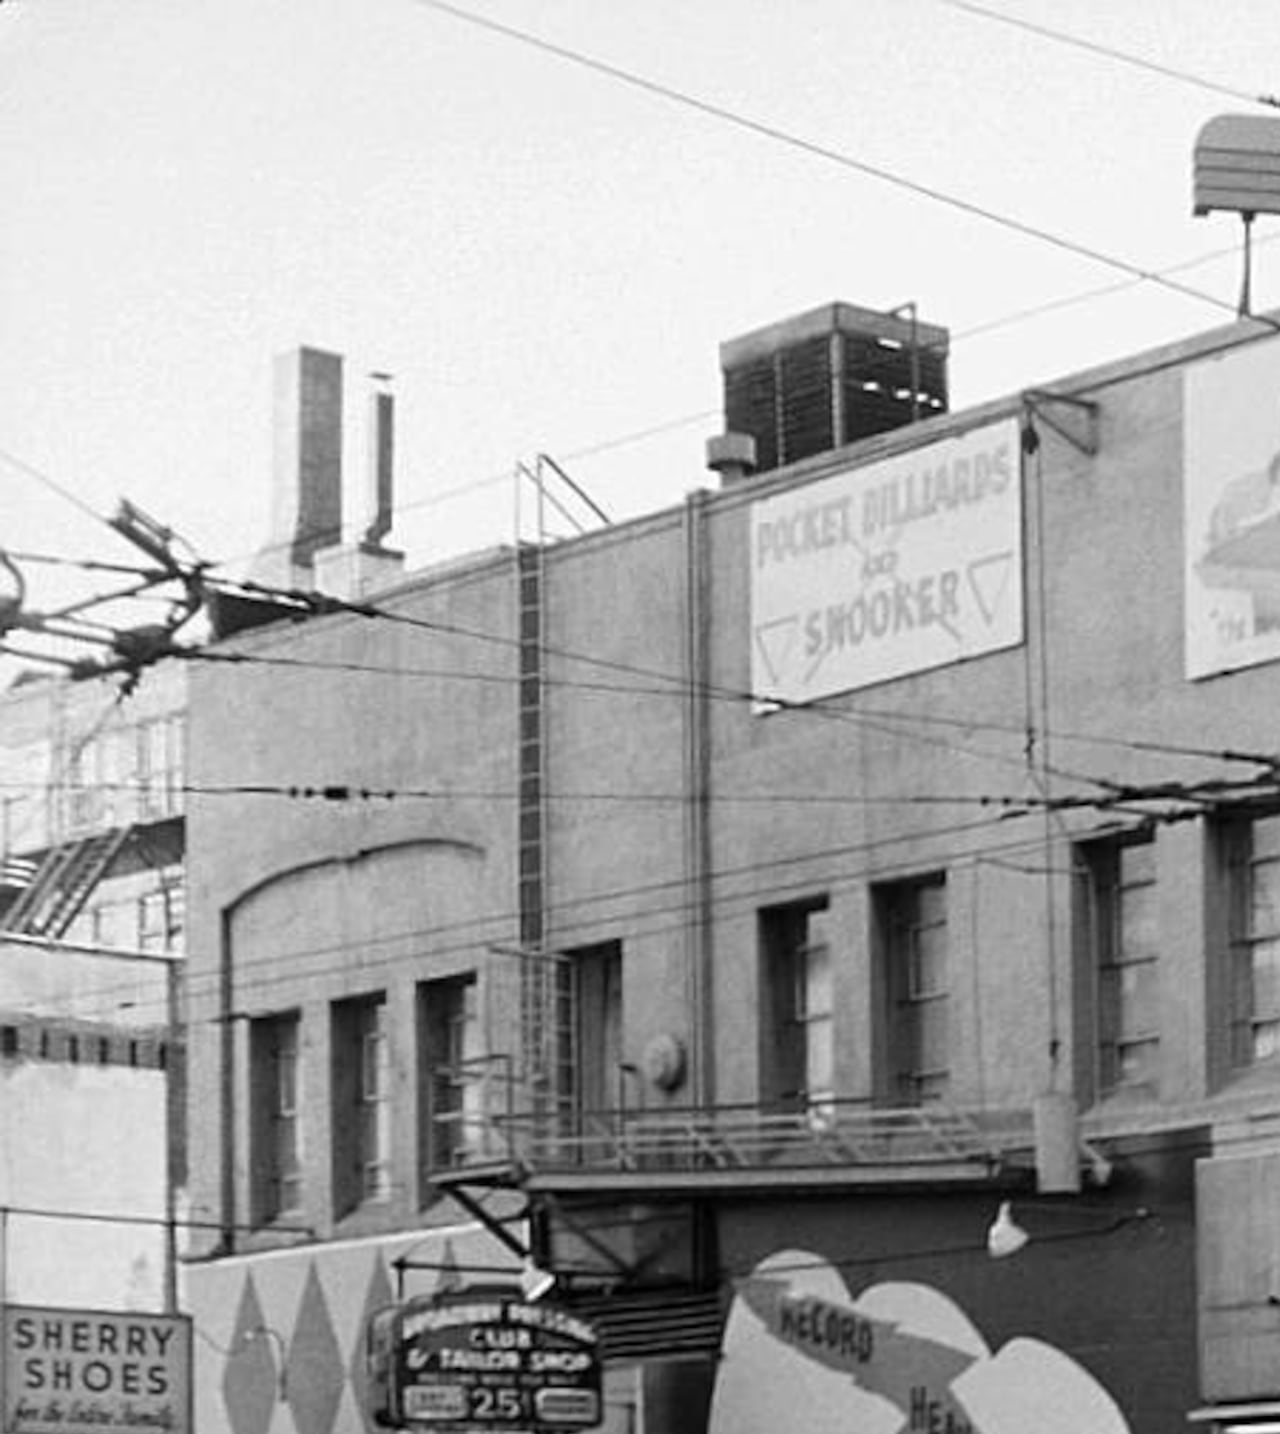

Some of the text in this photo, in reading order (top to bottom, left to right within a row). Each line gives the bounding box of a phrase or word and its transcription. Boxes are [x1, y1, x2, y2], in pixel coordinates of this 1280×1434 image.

[757, 443, 1010, 569] POCKET BILLIARDS
[805, 569, 960, 656] SNOOKER
[15, 1317, 174, 1357] SHERRY
[781, 1302, 874, 1365] RECORD
[25, 1358, 168, 1395] SHOES
[529, 1351, 591, 1372] SHOP
